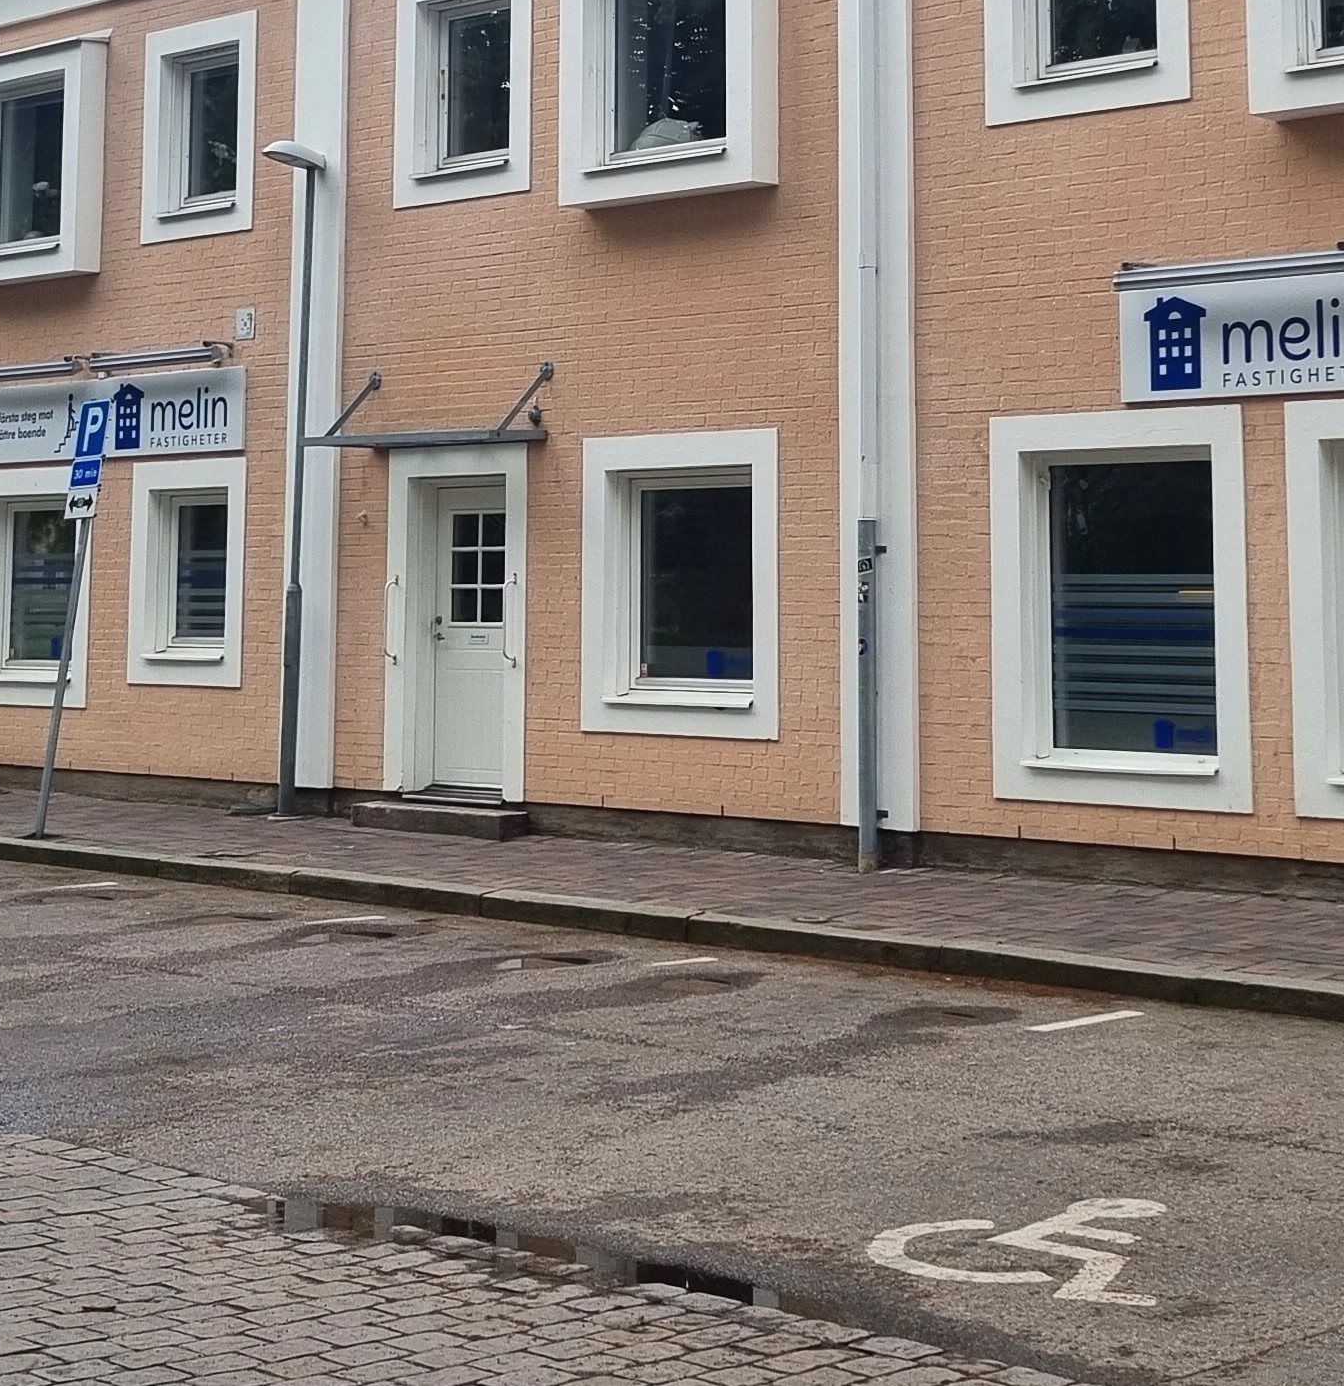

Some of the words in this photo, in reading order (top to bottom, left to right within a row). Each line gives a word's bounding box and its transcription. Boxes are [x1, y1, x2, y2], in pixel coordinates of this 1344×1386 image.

[21, 410, 37, 424] steg
[38, 409, 54, 420] mot
[150, 386, 228, 432] melin
[17, 426, 47, 439] boende
[82, 406, 104, 452] P
[150, 433, 228, 448] FASTIGHETER
[73, 468, 84, 480] 30
[84, 467, 98, 479] min
